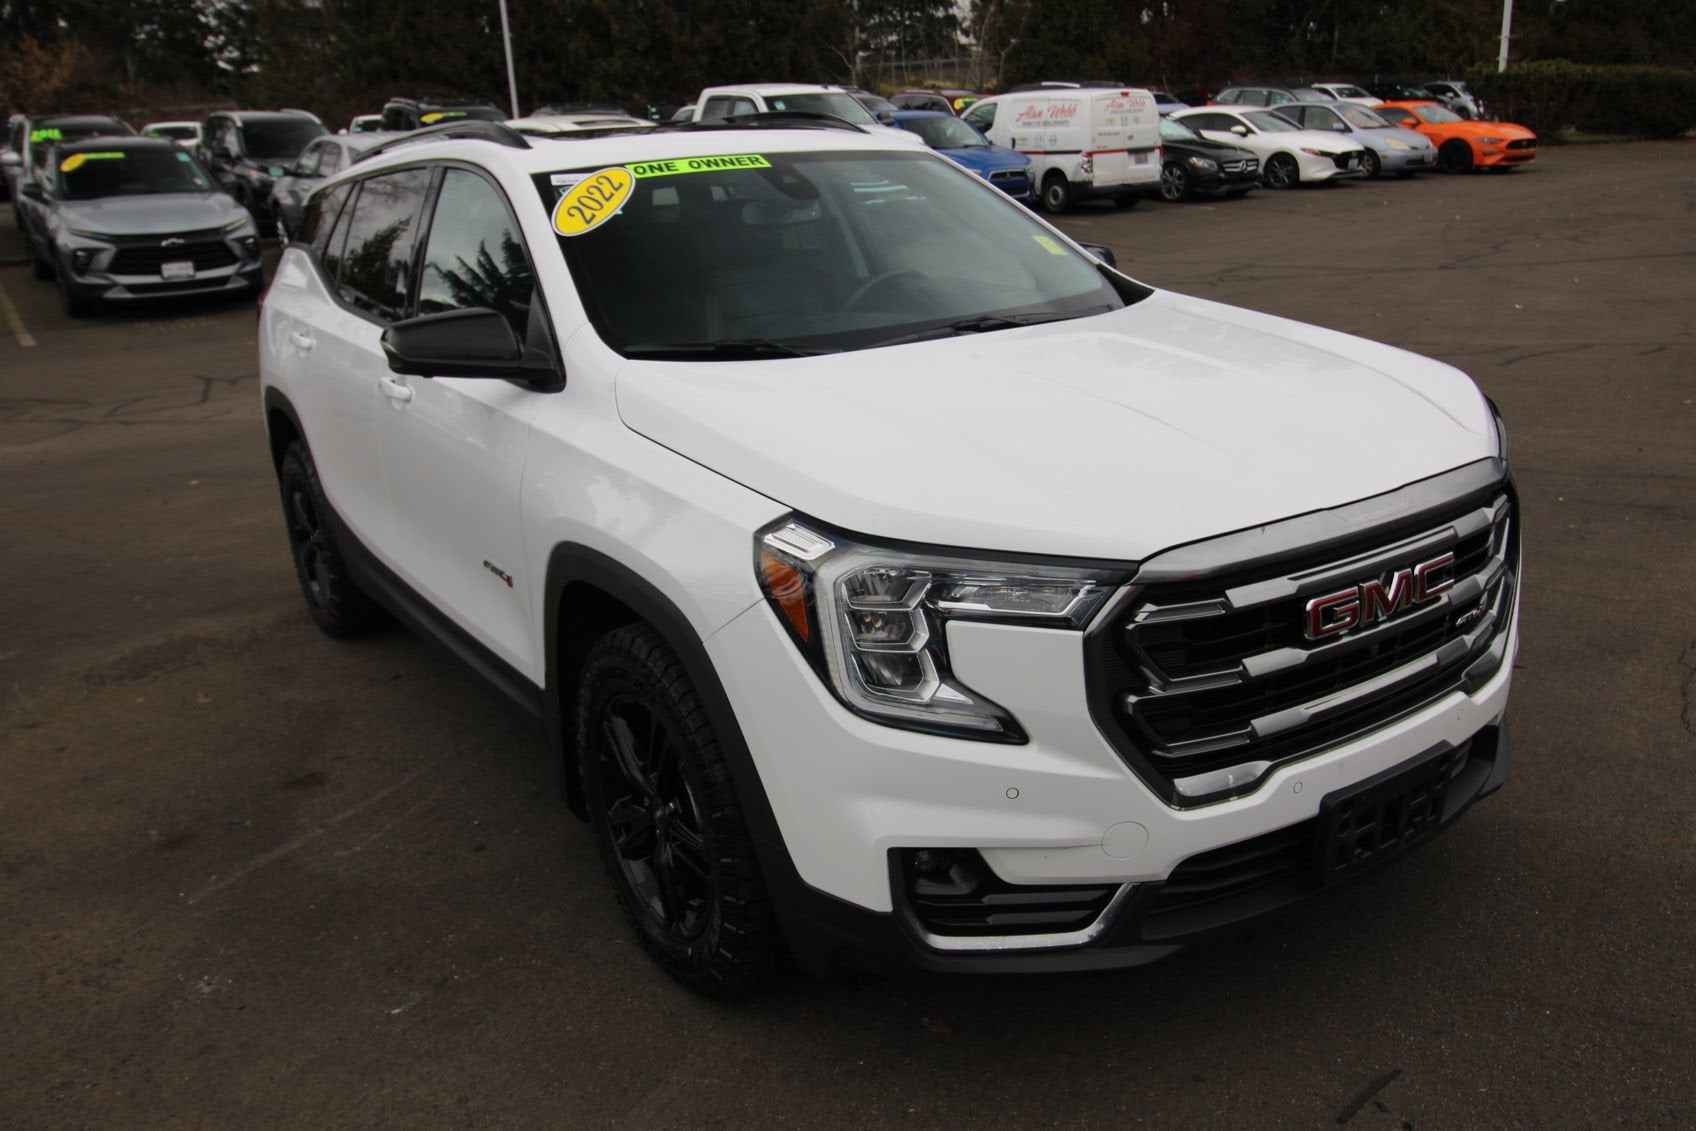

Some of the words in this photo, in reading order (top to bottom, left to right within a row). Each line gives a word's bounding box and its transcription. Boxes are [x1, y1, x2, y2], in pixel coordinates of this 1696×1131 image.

[1048, 102, 1078, 118] Webb
[634, 162, 679, 176] ONE
[688, 156, 764, 170] OWNER
[567, 175, 624, 225] 2022
[1305, 551, 1455, 640] GMC
